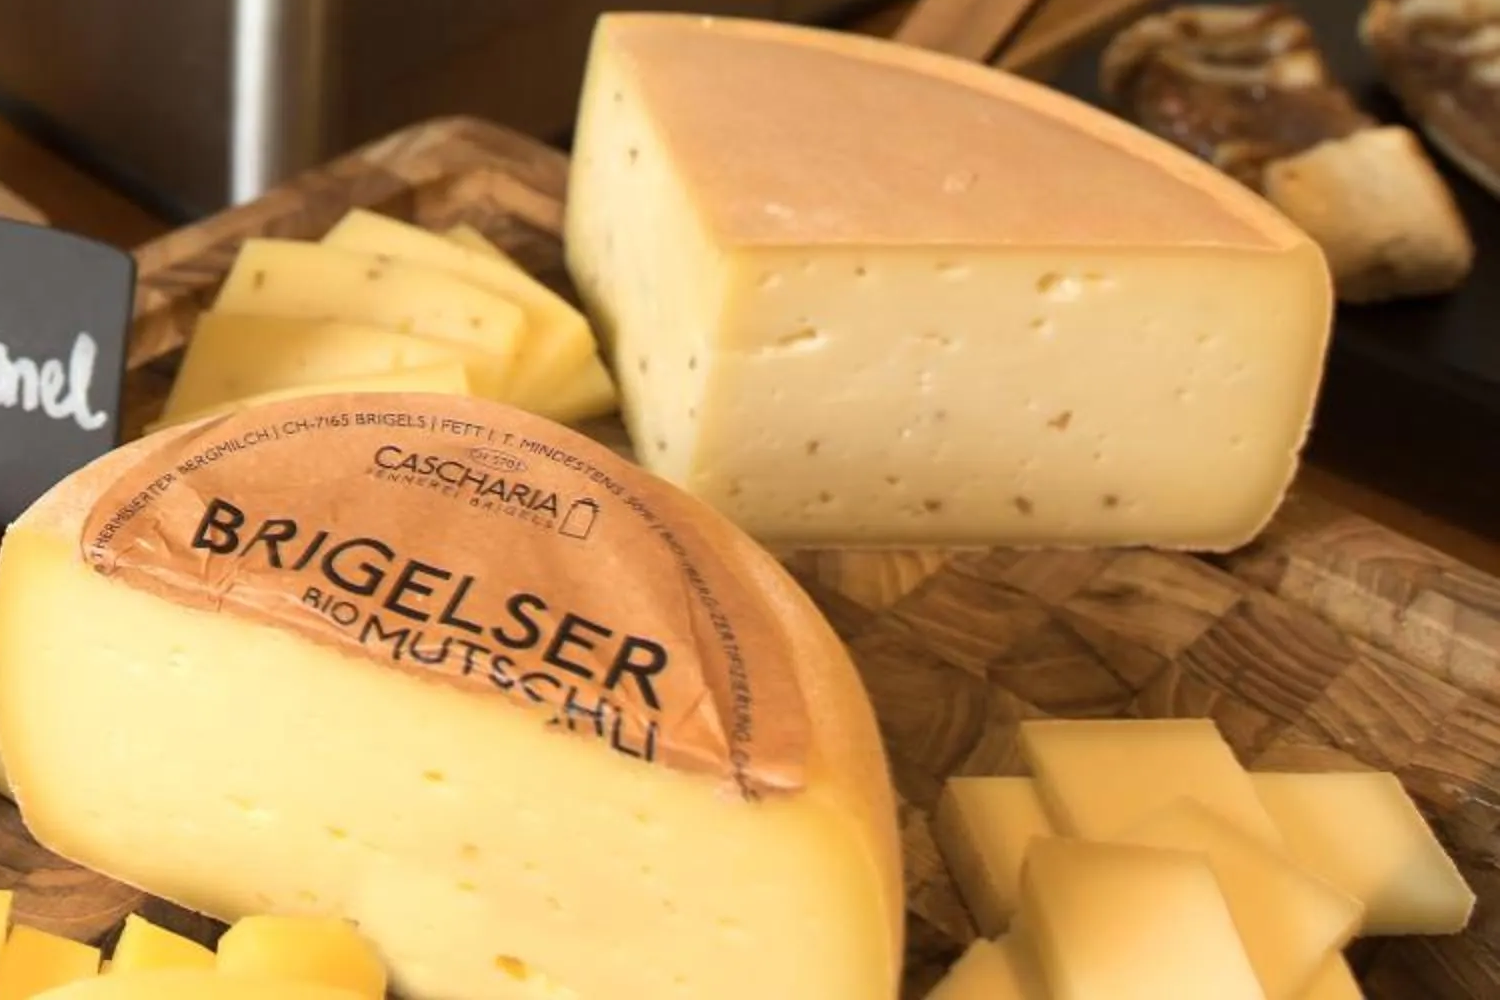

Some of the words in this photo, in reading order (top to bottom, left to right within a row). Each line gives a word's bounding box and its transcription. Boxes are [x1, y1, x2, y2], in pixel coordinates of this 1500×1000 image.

[177, 426, 271, 477] BERGMILCH
[282, 413, 350, 437] CH-7165
[355, 412, 426, 430] BRIGELS
[441, 418, 485, 438] FETT
[519, 437, 626, 497] MINDESTENS
[374, 444, 558, 519] CASCHARIA
[191, 497, 668, 711] BRIGELSER
[359, 613, 658, 763] MUTSCHLI
